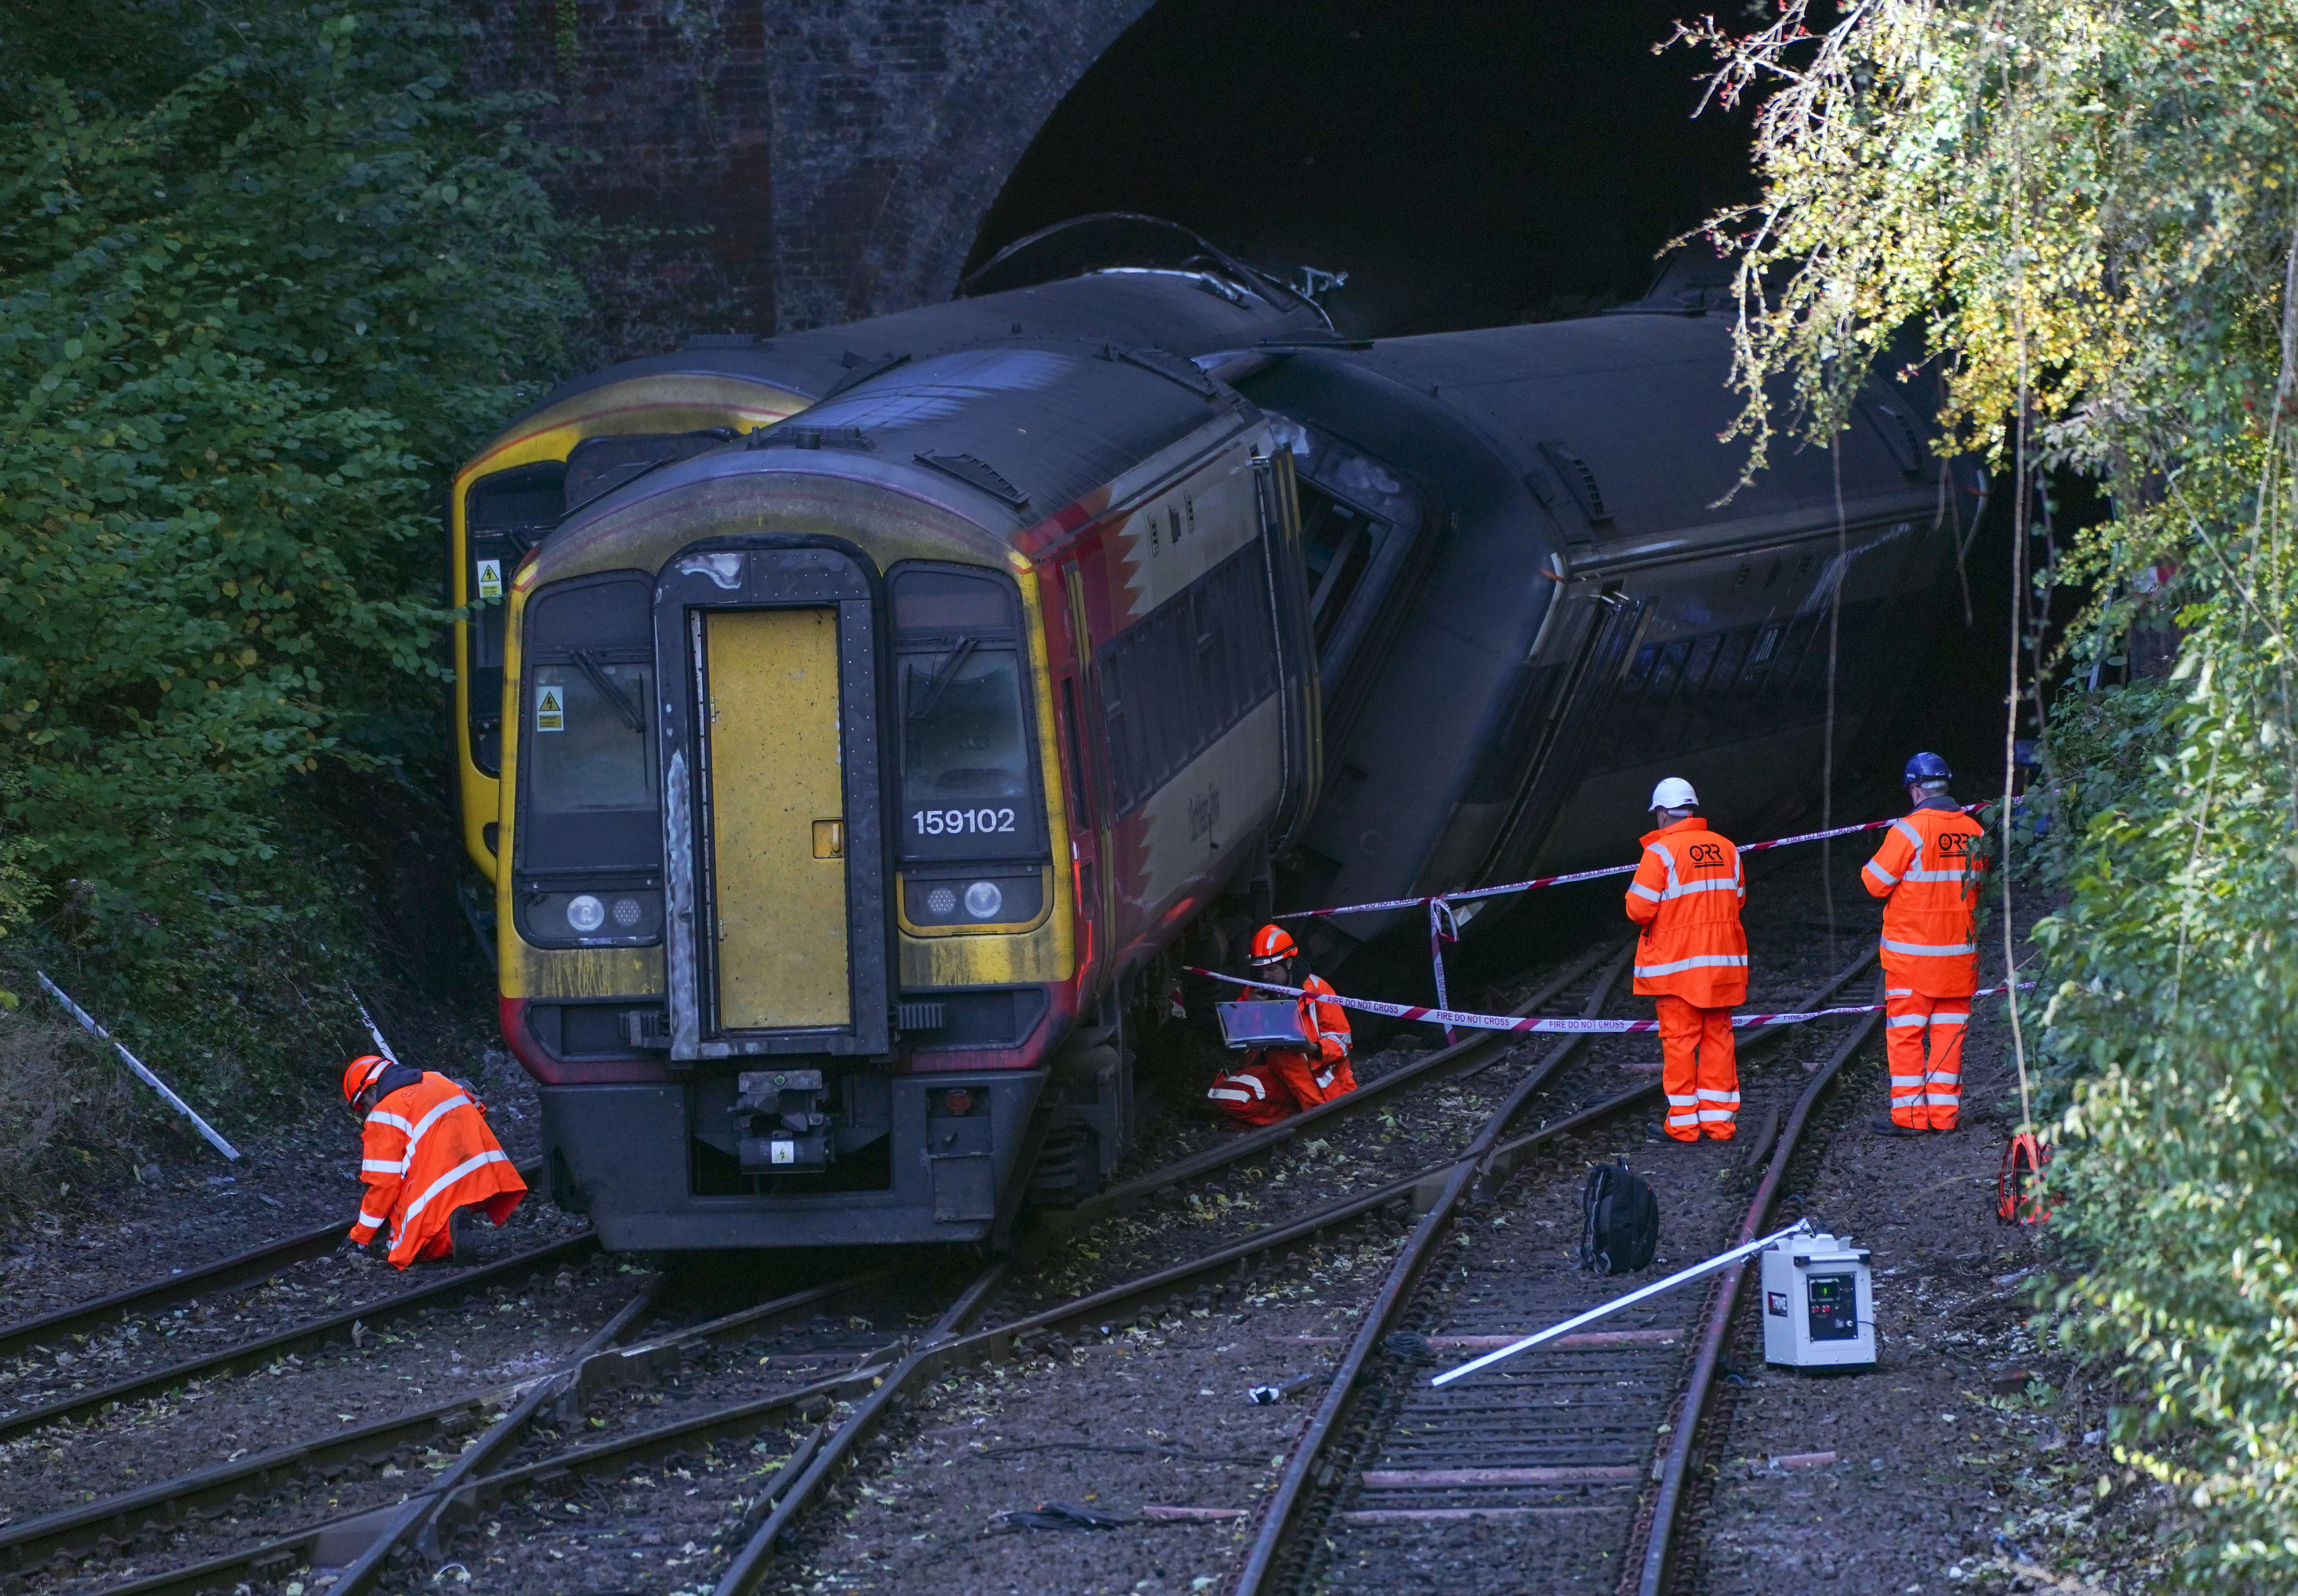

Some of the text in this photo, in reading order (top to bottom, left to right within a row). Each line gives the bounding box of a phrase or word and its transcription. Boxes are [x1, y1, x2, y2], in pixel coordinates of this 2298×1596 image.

[913, 809, 1014, 834] 159102
[1833, 826, 1858, 835] CROSS
[1689, 844, 1723, 861] ORR
[1328, 996, 1343, 1005] FIRE
[1358, 1002, 1372, 1010] NOT
[1374, 1003, 1399, 1013] CROSS
[1437, 1011, 1510, 1026] FIRE DO NOT CROSS
